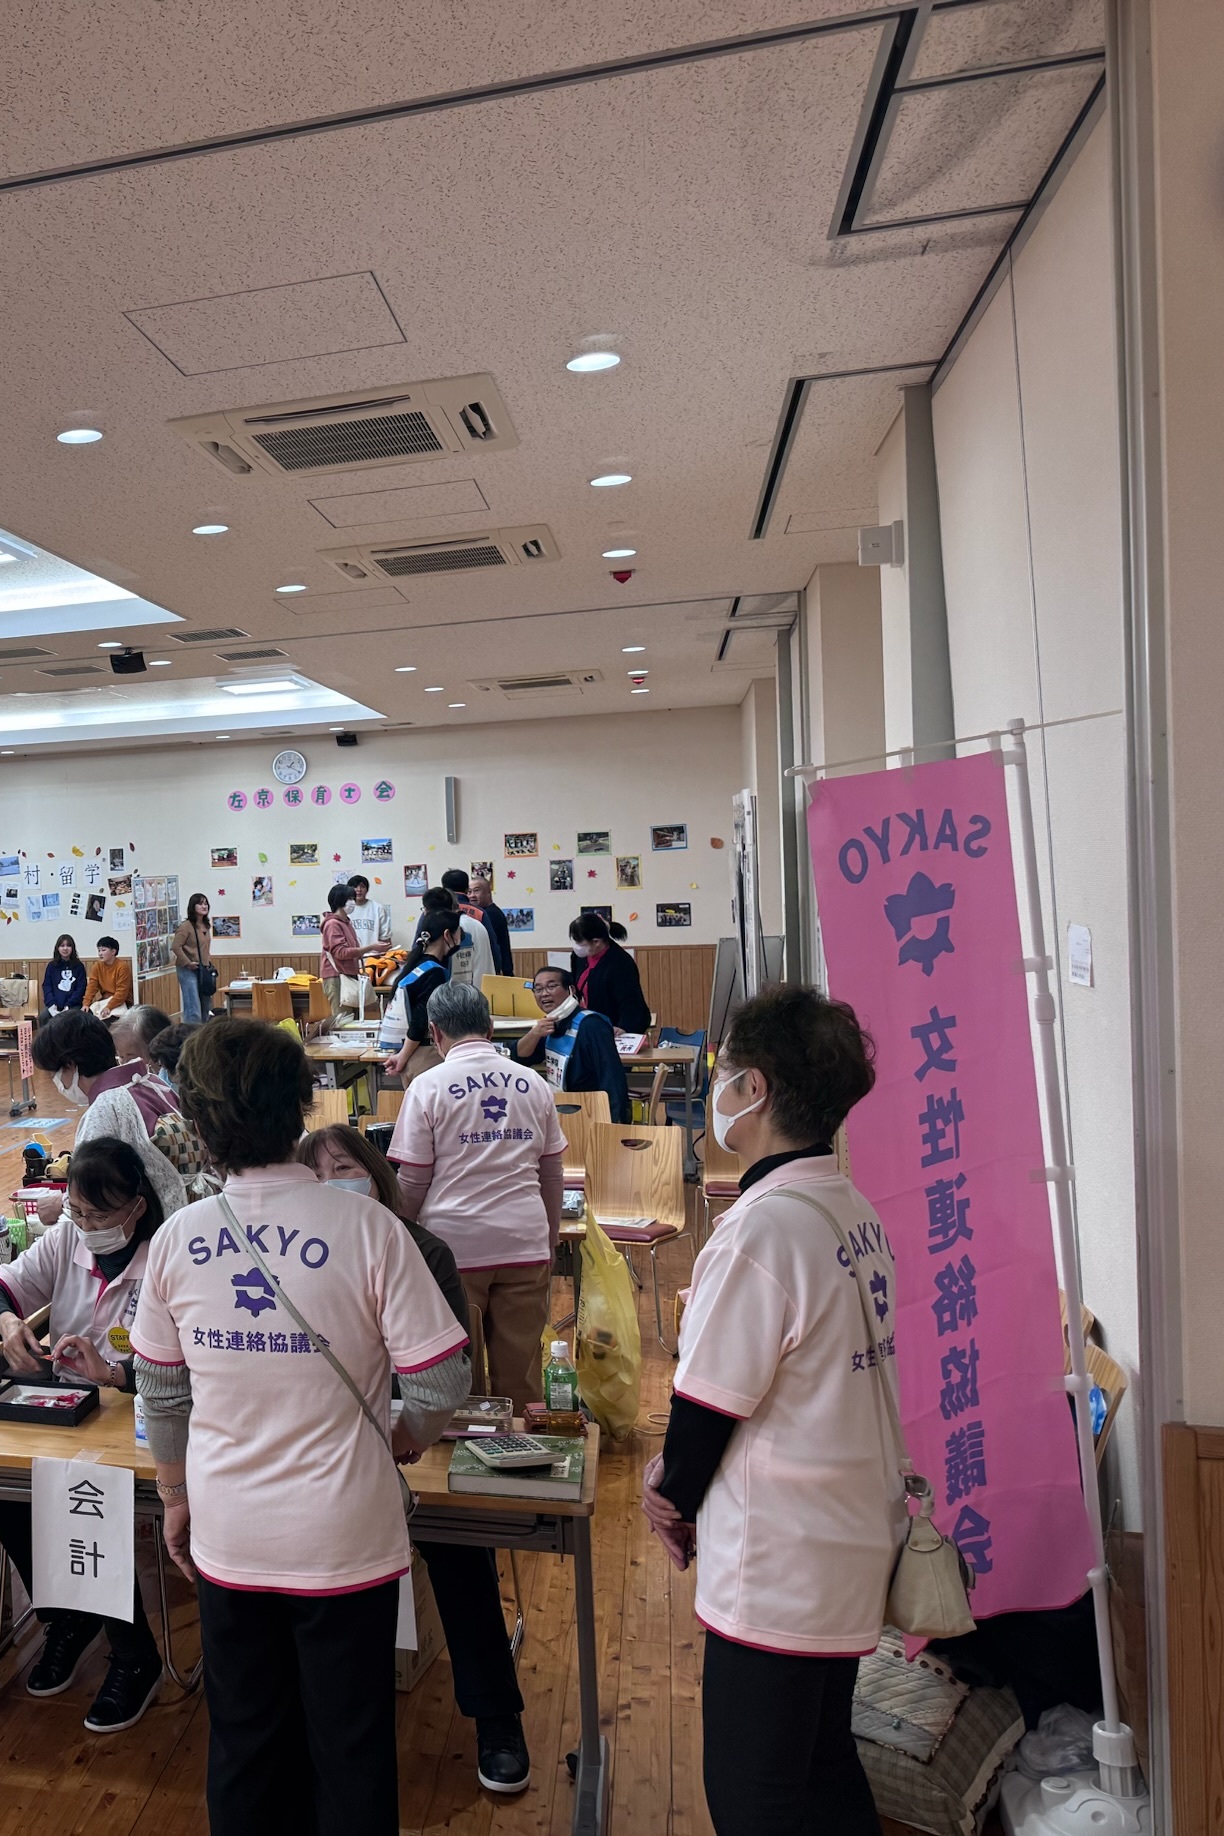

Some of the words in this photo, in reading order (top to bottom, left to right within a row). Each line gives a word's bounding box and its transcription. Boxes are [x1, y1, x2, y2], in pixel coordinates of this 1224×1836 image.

[228, 780, 393, 809] 左京保育士会
[448, 1072, 530, 1100] SAKYO
[458, 1128, 534, 1145] 女性連絡協議会
[188, 1224, 330, 1269] SAKYO
[836, 1221, 895, 1279] SAKY
[68, 1479, 105, 1578] 会計
